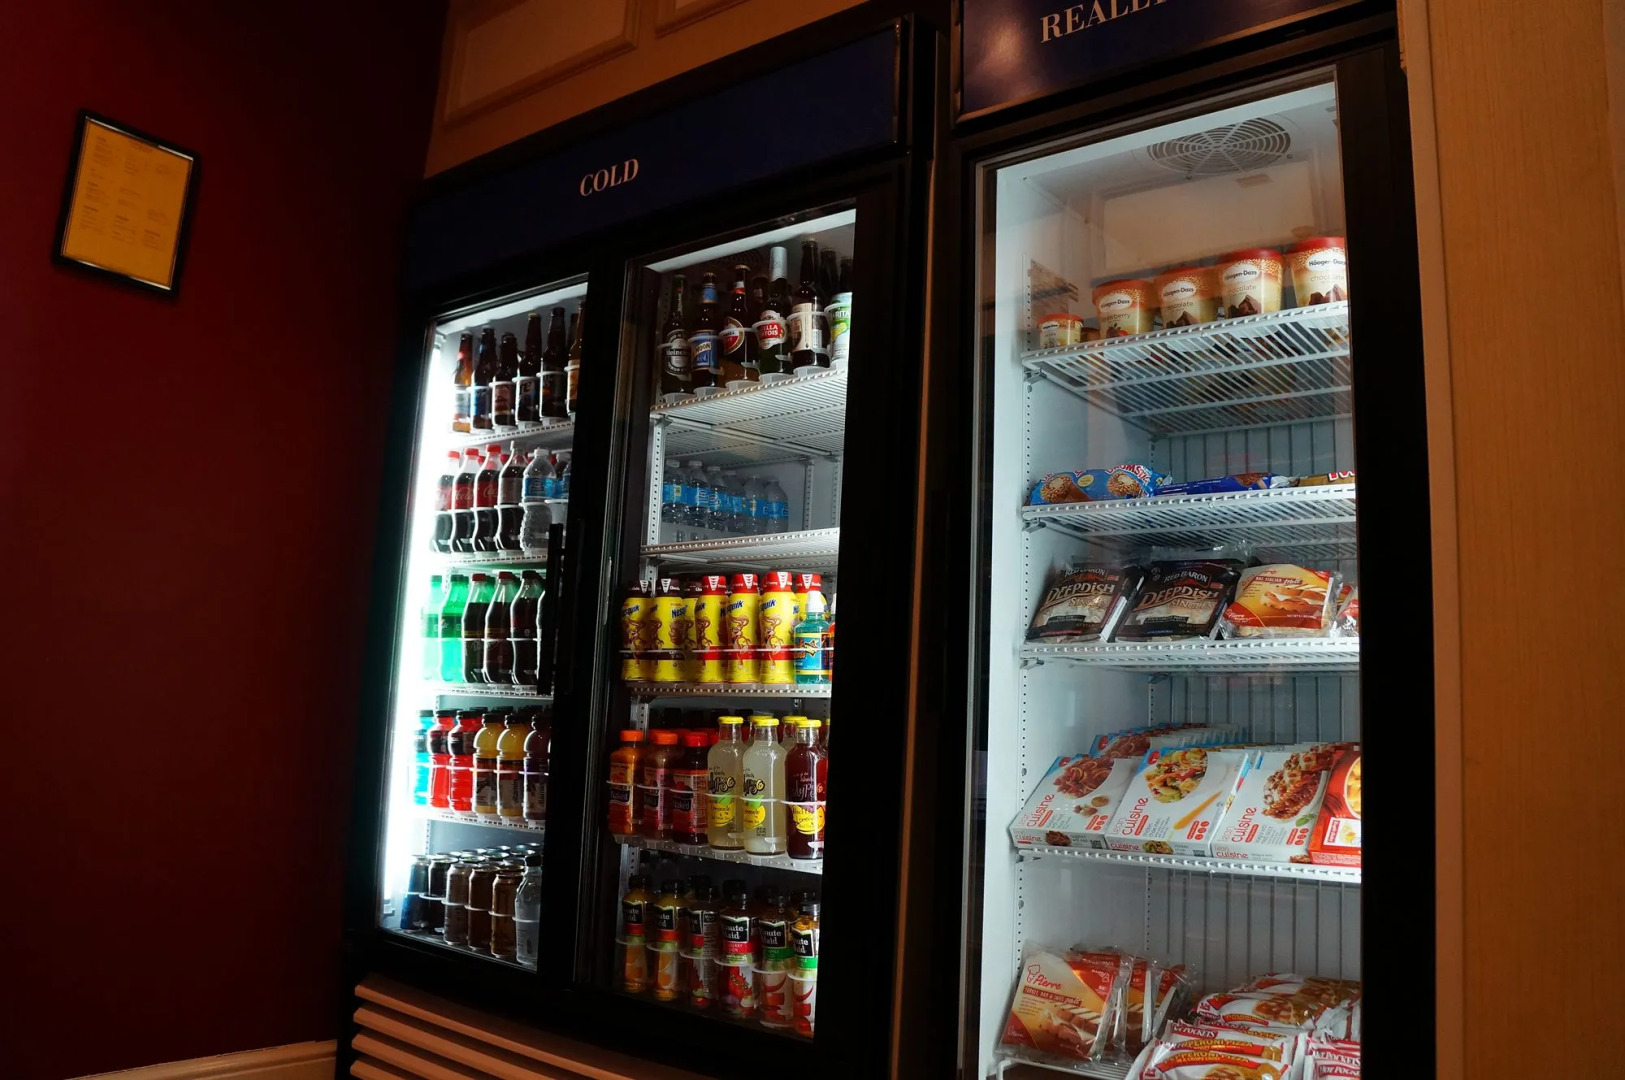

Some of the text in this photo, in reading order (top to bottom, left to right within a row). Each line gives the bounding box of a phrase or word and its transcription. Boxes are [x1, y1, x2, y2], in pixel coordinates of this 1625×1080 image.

[579, 158, 639, 197] COLD
[1180, 570, 1209, 583] BARON
[1121, 796, 1150, 836] cuisine
[1231, 806, 1257, 843] cuisine
[1110, 842, 1140, 852] cuisine
[1216, 850, 1249, 860] cuisine
[1033, 973, 1063, 990] Pierre
[1181, 1026, 1218, 1039] POCKETS
